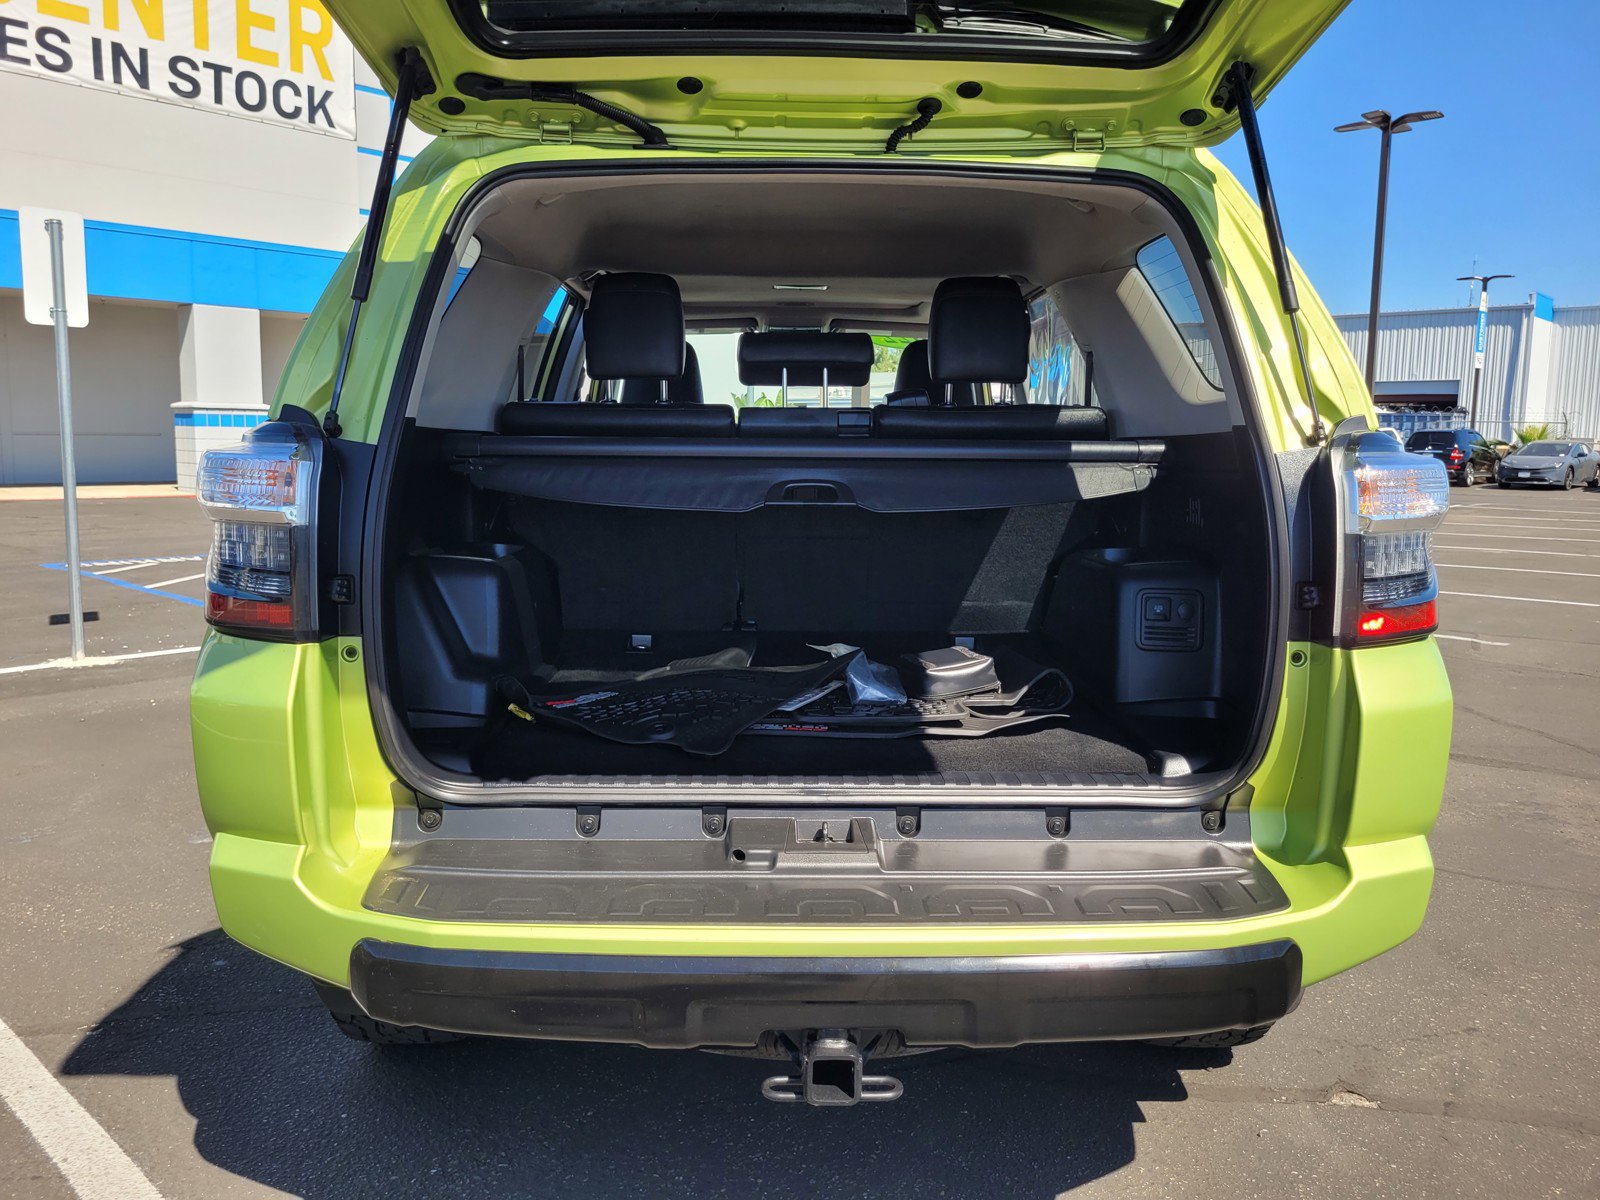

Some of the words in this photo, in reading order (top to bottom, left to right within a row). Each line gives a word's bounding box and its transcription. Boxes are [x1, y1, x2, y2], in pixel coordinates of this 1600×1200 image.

[0, 16, 73, 73] ES
[91, 36, 150, 90] IN
[168, 55, 336, 129] STOCK
